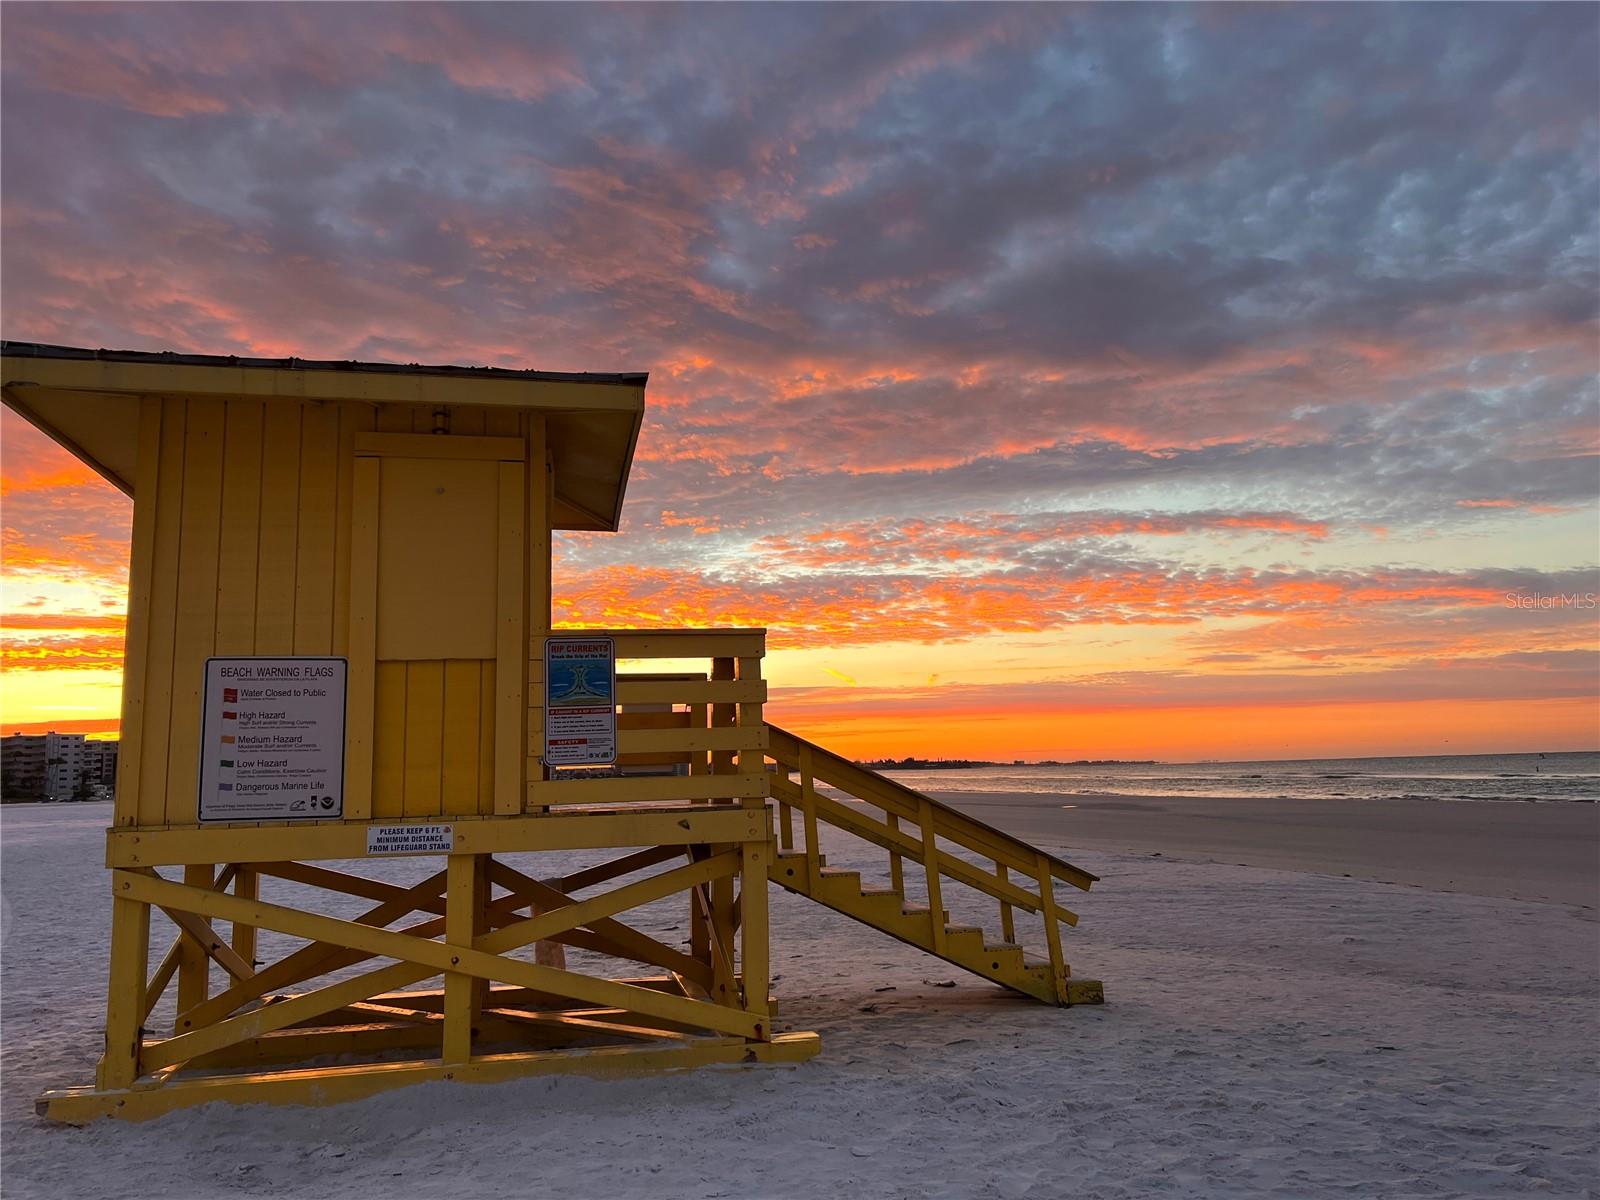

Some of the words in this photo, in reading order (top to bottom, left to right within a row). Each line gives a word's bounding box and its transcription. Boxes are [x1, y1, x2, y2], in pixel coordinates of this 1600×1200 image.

[567, 644, 608, 652] CURRENTS
[220, 667, 252, 677] BEACH
[257, 667, 300, 677] WARNING
[304, 667, 334, 677] FLAGS
[265, 688, 292, 696] Closed
[239, 712, 257, 721] High
[236, 783, 279, 792] Dangerous
[310, 781, 325, 789] Life
